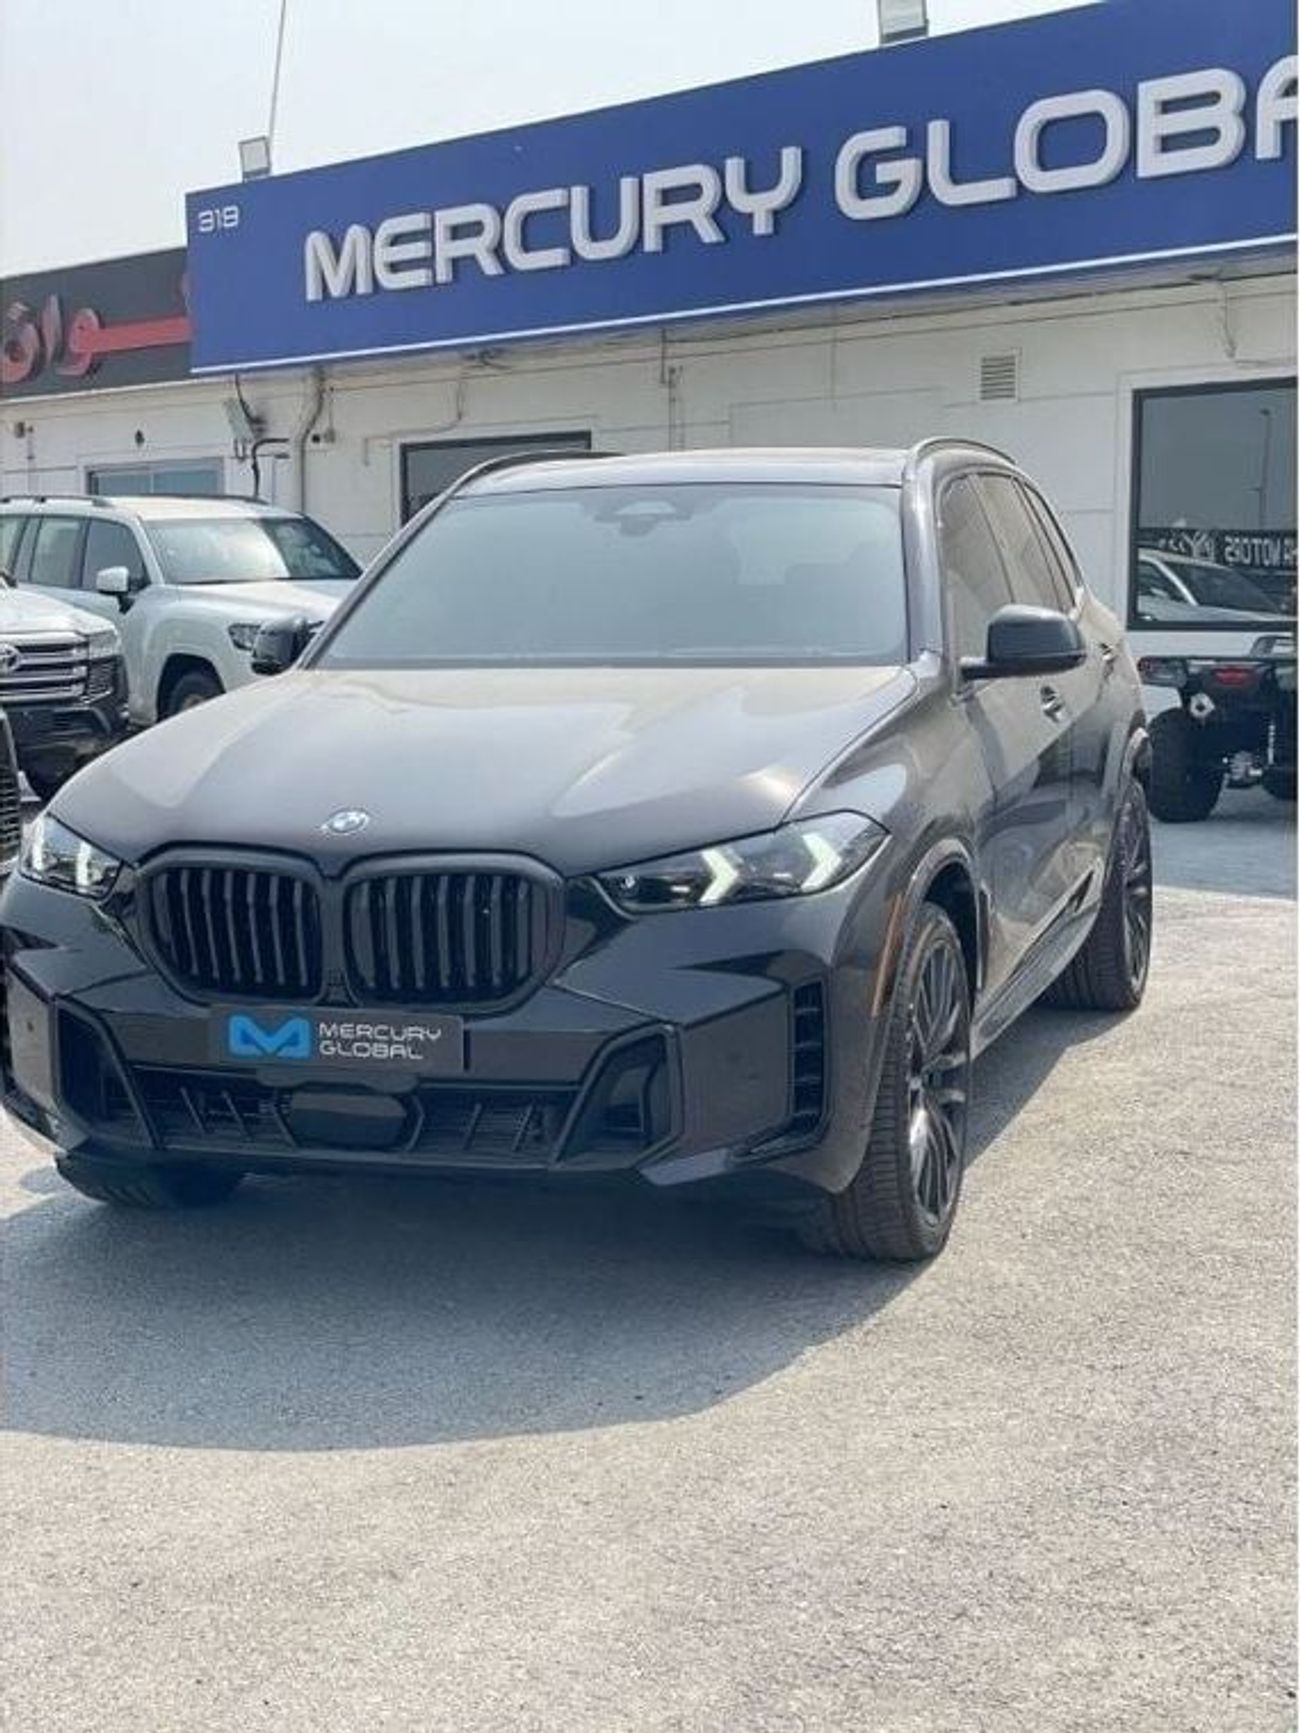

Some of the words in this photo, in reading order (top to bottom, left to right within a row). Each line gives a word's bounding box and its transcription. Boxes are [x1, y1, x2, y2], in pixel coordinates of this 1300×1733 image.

[305, 146, 802, 301] MERCURY
[319, 1021, 442, 1042] MERCURY
[319, 1040, 424, 1060] GLOBAL
